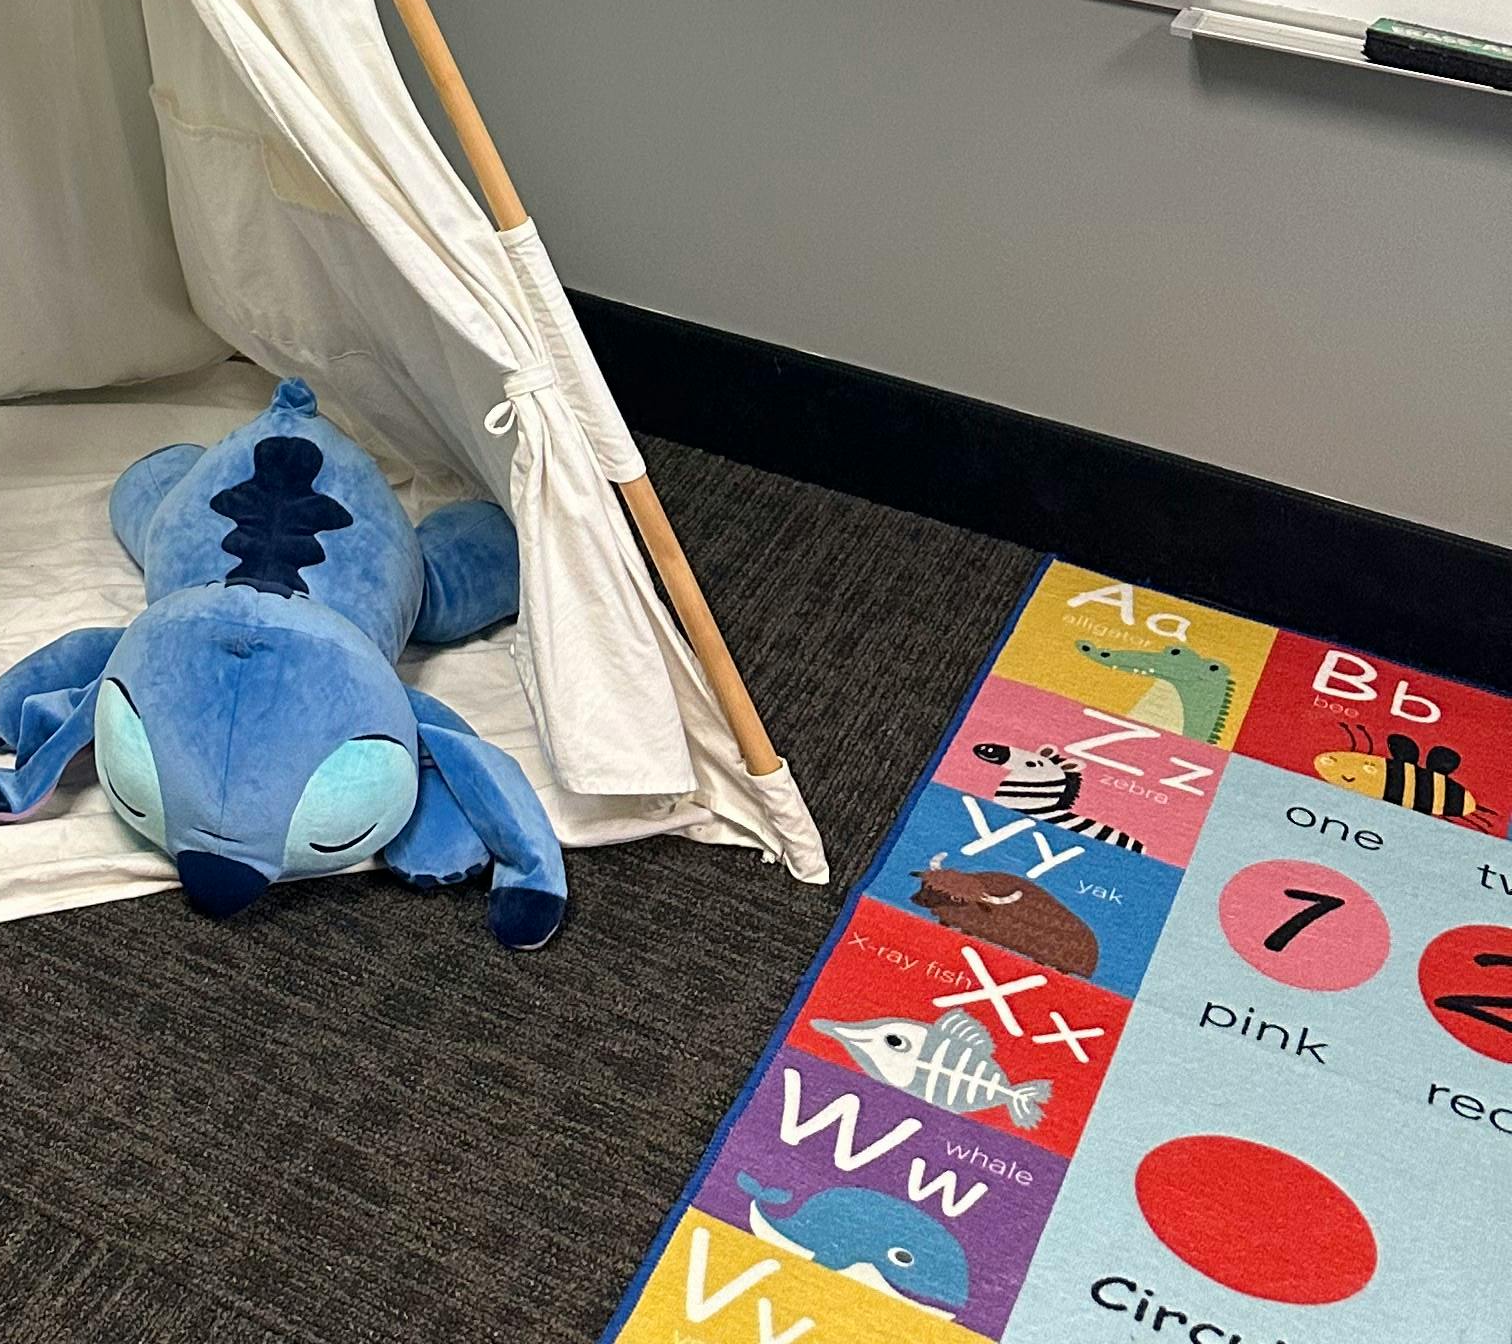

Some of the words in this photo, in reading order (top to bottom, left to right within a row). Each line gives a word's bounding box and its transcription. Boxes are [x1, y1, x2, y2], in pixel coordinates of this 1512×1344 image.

[1063, 615, 1154, 648] alligator
[1100, 772, 1170, 806] zebra
[1285, 805, 1385, 853] one
[1077, 879, 1126, 905] yak
[846, 931, 919, 972] X-ray
[925, 961, 973, 988] fish
[1199, 1001, 1329, 1064] pink
[945, 1138, 1034, 1187] whale
[1091, 1276, 1288, 1344] Circ
